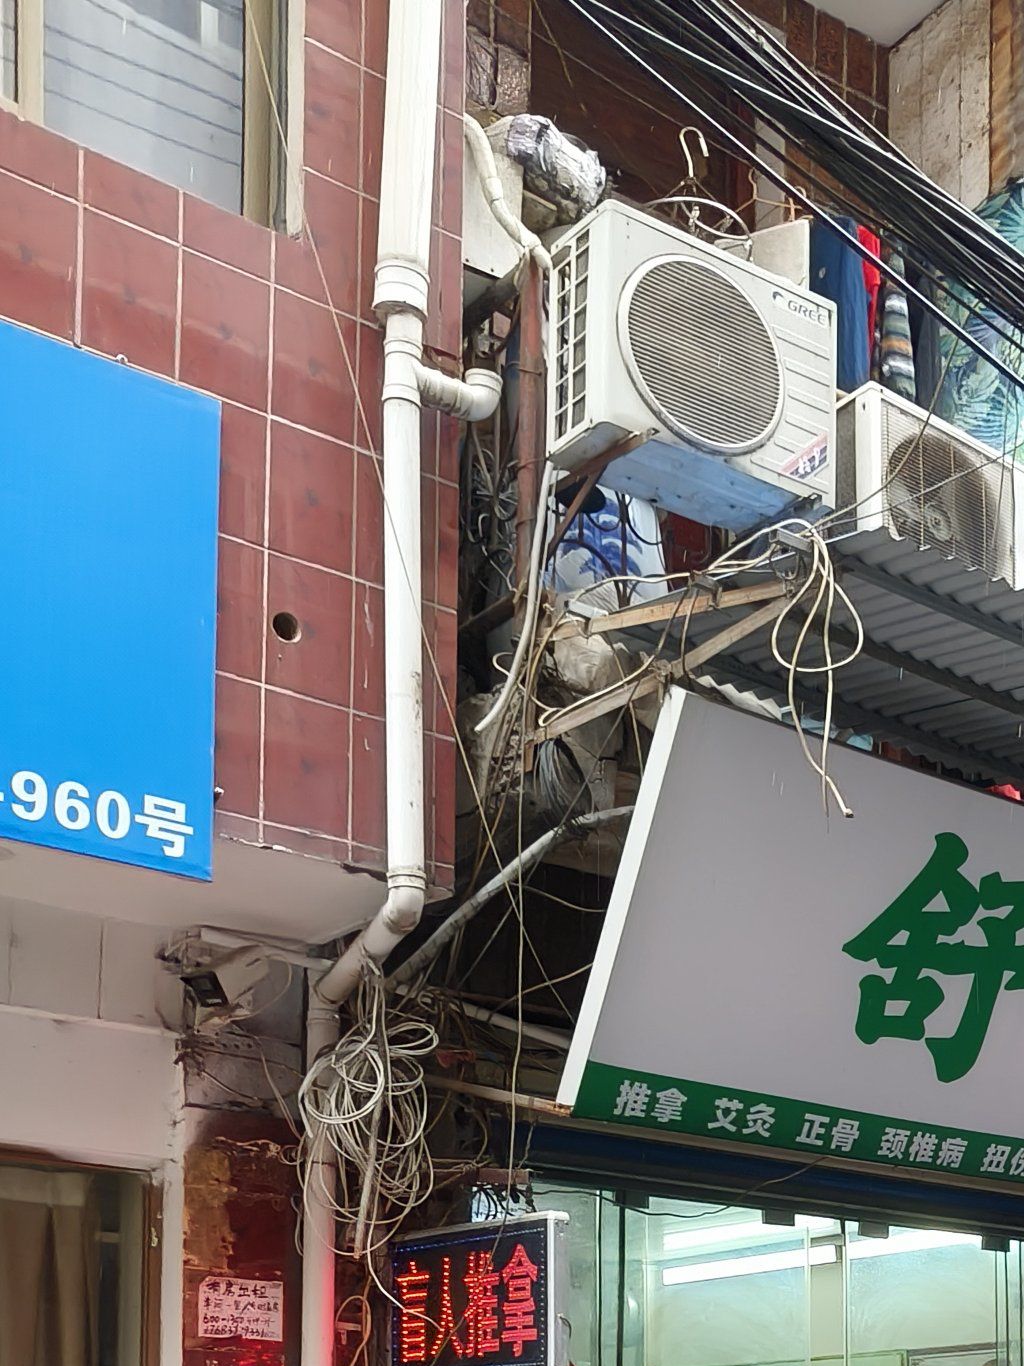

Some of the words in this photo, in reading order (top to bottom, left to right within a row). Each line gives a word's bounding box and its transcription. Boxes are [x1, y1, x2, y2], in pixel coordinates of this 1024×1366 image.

[788, 299, 827, 326] GREE
[613, 1079, 688, 1123] 推拿
[707, 1097, 776, 1138] 艾灸
[795, 1112, 860, 1152] 正骨
[876, 1127, 969, 1169] 颈椎病
[396, 1243, 539, 1363] 盲人推拿
